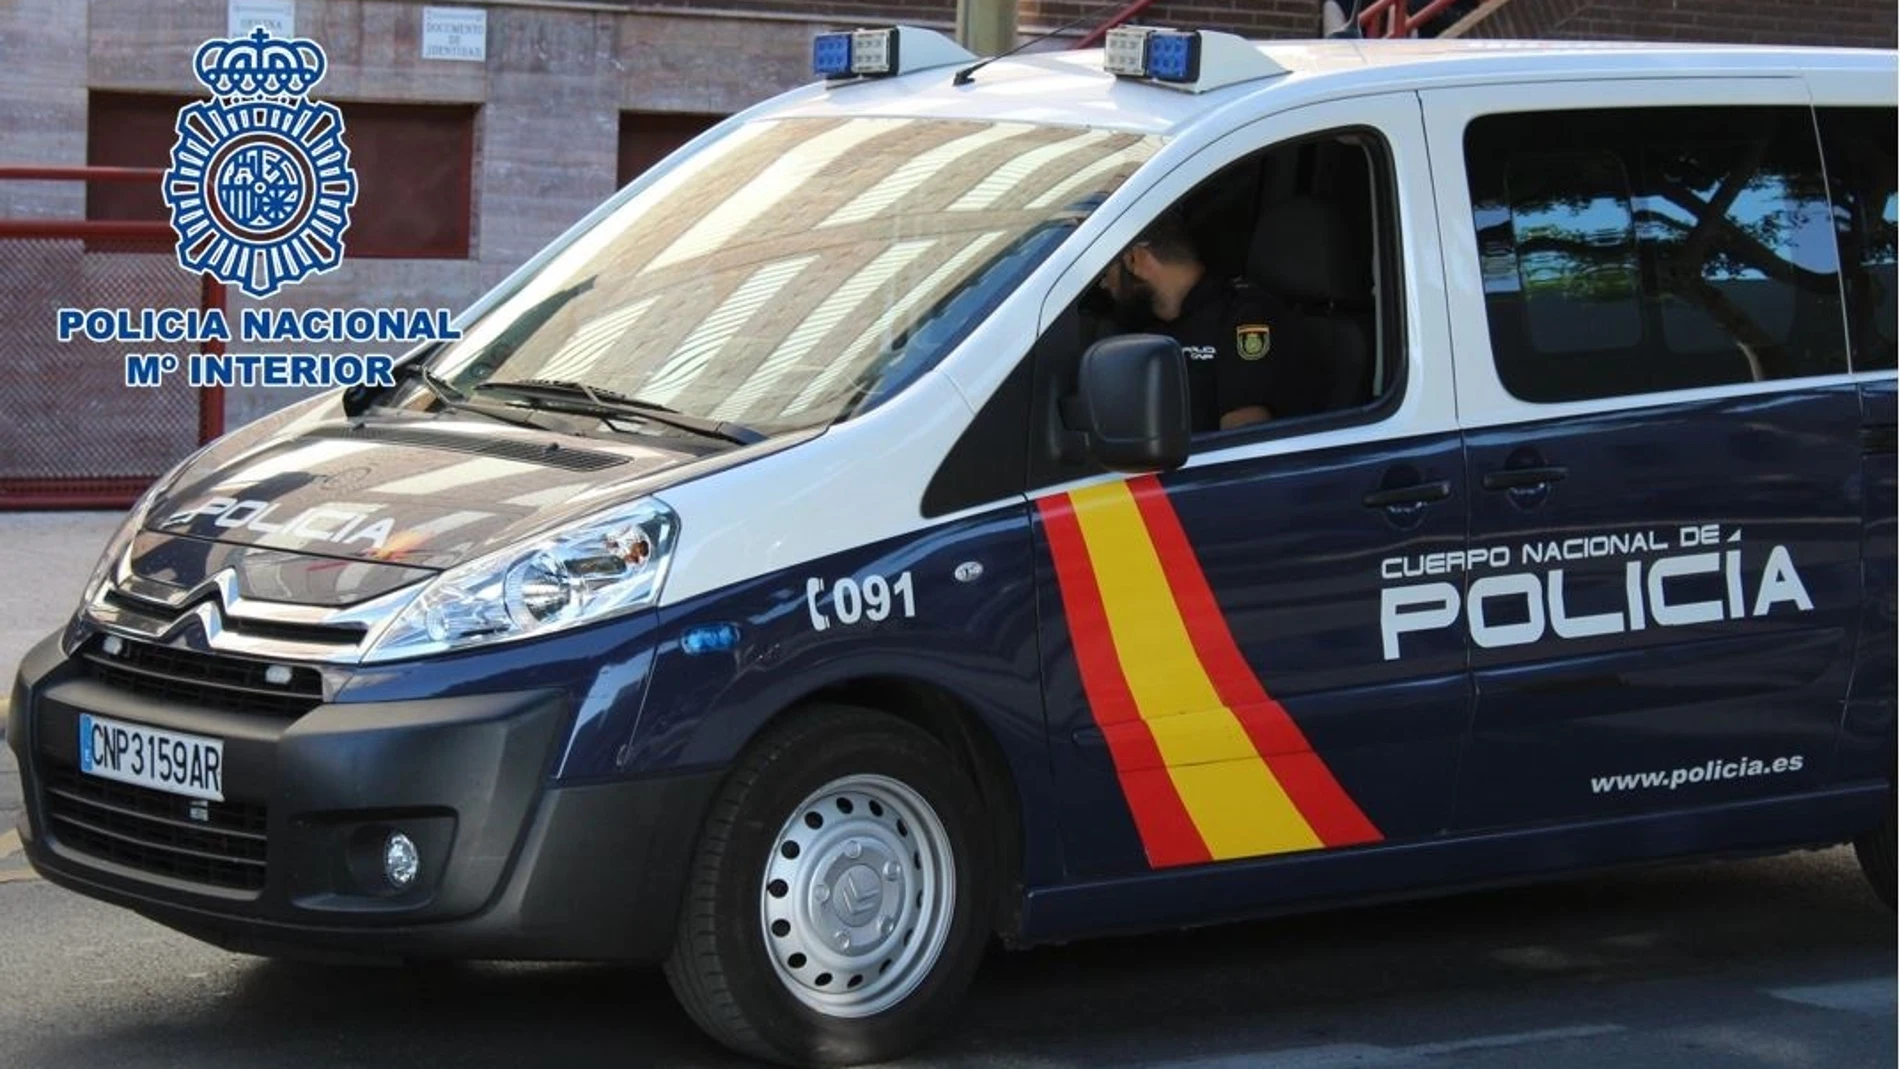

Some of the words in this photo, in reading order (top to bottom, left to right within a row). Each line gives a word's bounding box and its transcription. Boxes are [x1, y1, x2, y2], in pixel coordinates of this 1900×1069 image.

[1381, 546, 1510, 579] CUERPO
[1522, 531, 1669, 565] NACIONAL
[1680, 523, 1720, 547] DE
[833, 571, 916, 624] 091
[1380, 528, 1814, 660] POLICÍA
[91, 723, 220, 792] CNP3159AR
[1590, 754, 1804, 793] www.policia.es
